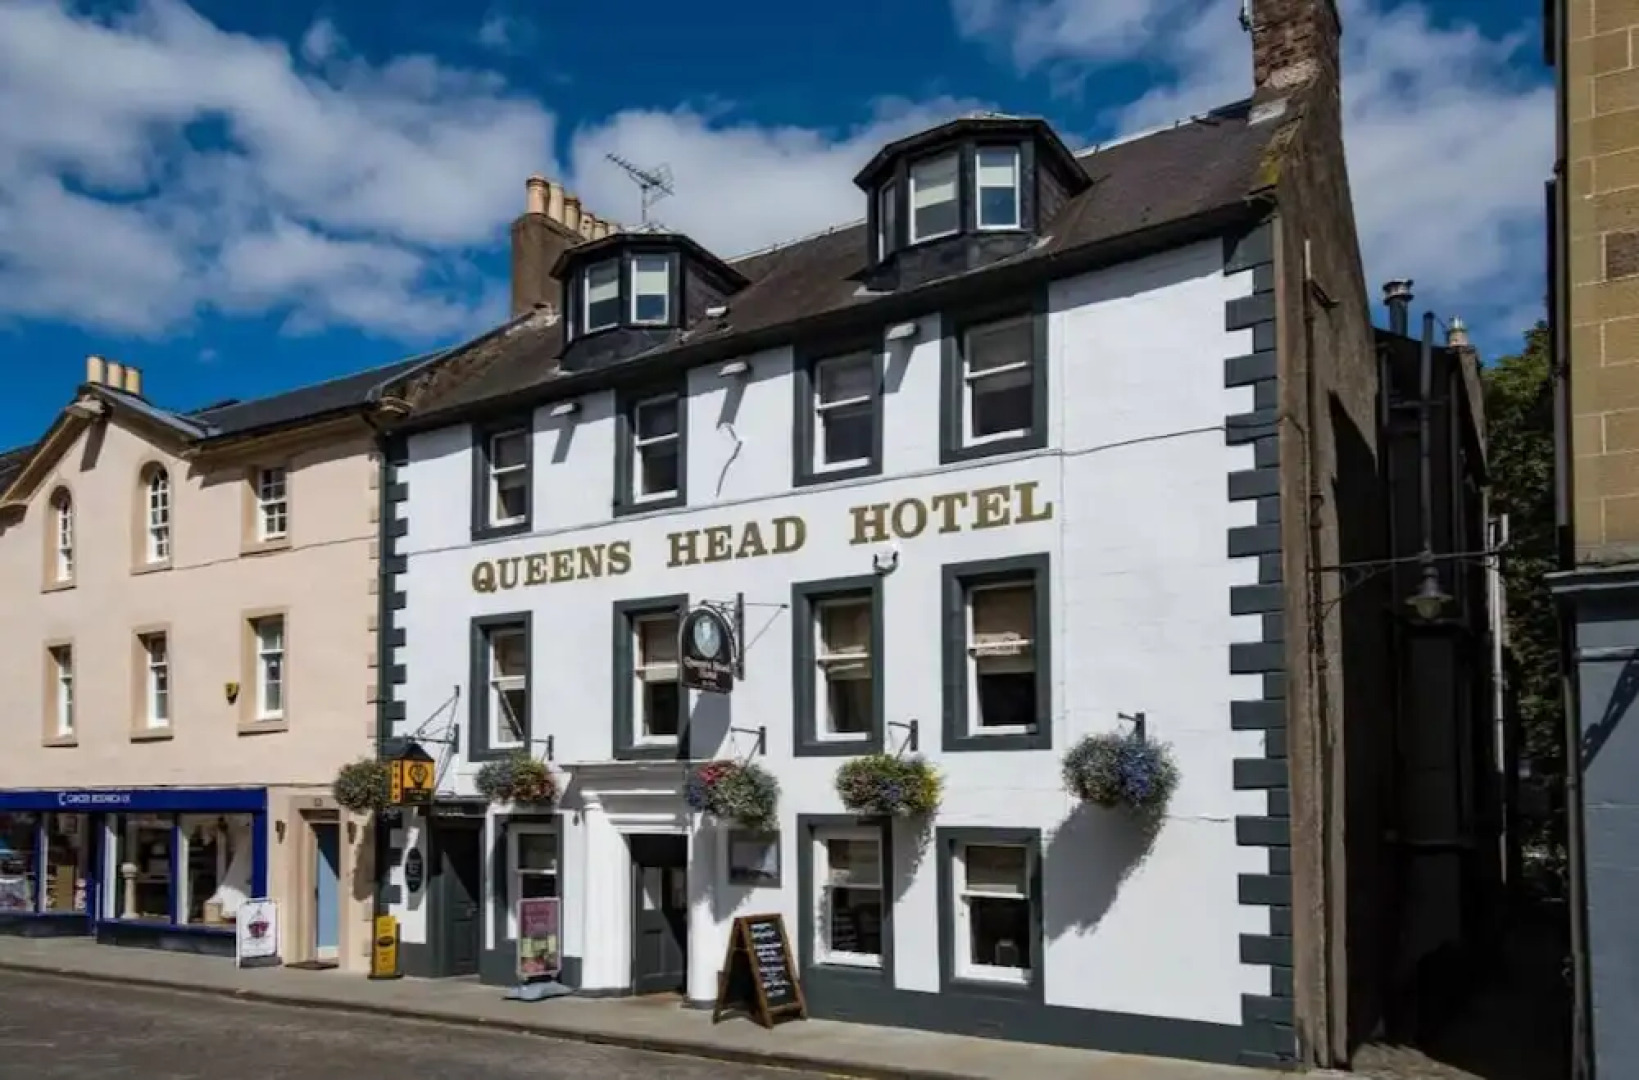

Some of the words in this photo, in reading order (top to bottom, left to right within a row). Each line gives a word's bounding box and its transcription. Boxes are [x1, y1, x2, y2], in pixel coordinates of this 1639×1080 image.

[472, 540, 631, 593] QUEENS
[667, 515, 807, 568] HEAD
[849, 480, 1053, 545] HOTEL
